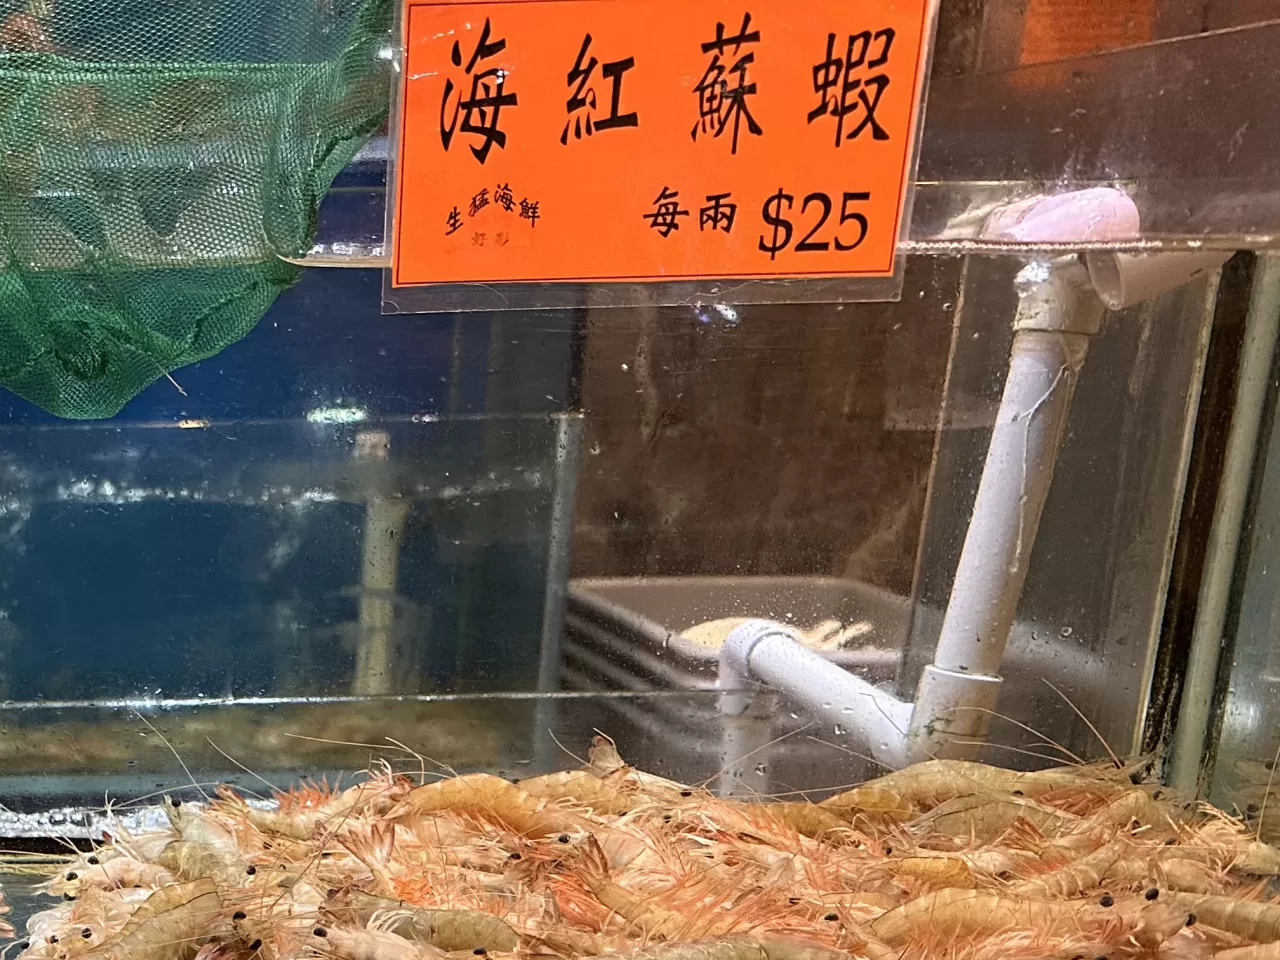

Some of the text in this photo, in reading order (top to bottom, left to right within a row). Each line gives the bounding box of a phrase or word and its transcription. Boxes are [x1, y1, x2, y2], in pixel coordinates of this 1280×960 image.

[439, 12, 896, 165] 海紅蘇蝦
[445, 182, 541, 236] 生猛海鮮
[642, 186, 871, 261] 每兩 $25
